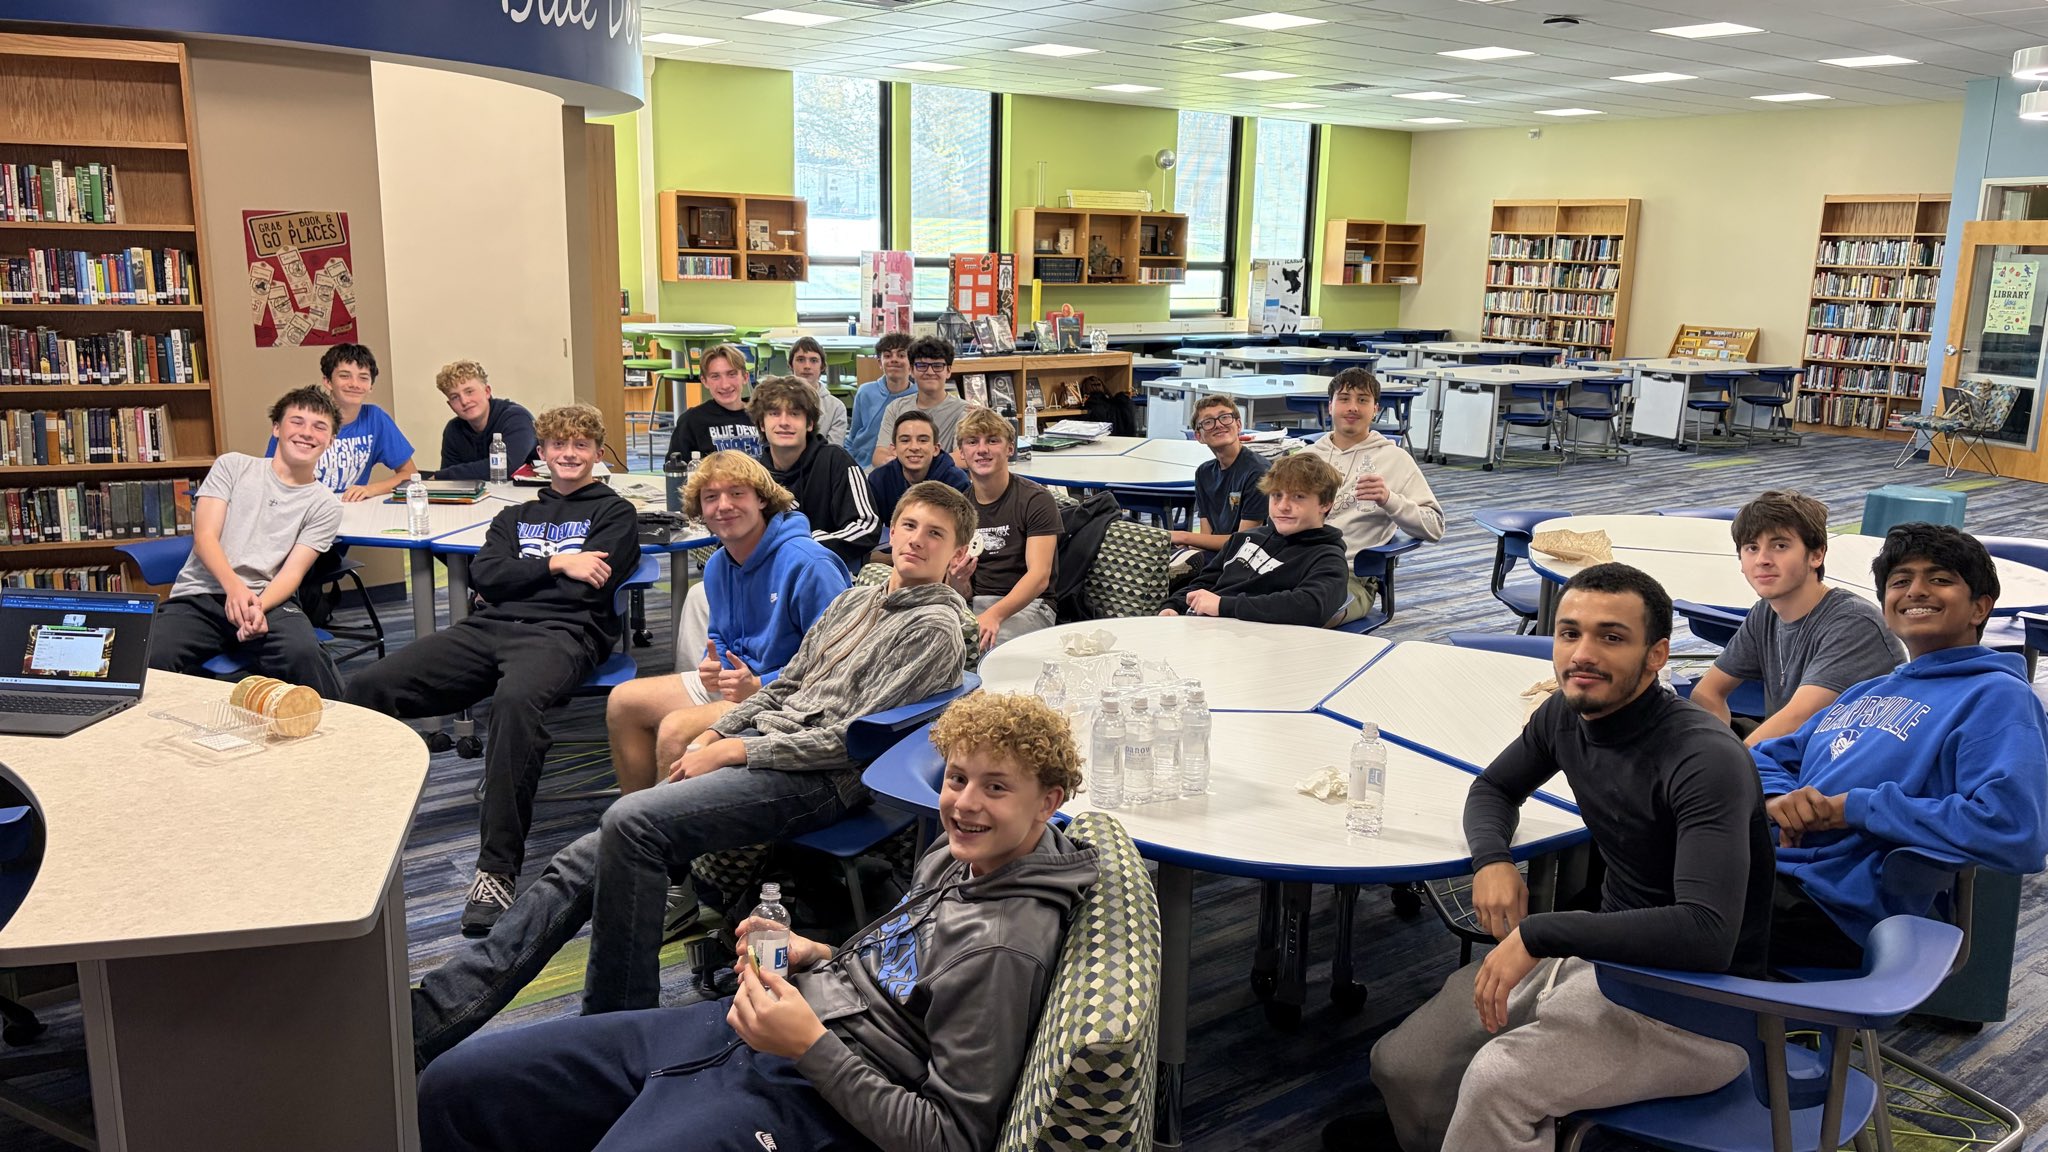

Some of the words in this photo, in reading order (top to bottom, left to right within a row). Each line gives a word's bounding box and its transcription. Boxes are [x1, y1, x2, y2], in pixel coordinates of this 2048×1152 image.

[258, 221, 282, 233] GRAB
[288, 220, 294, 229] A
[299, 216, 322, 228] BOOK
[326, 214, 332, 223] &
[262, 232, 281, 248] GO
[288, 223, 337, 245] PLACES
[1993, 290, 2030, 299] LIBRARY
[709, 424, 735, 438] BLUE
[546, 519, 591, 542] DEVILS
[761, 1133, 778, 1151] NIKE
